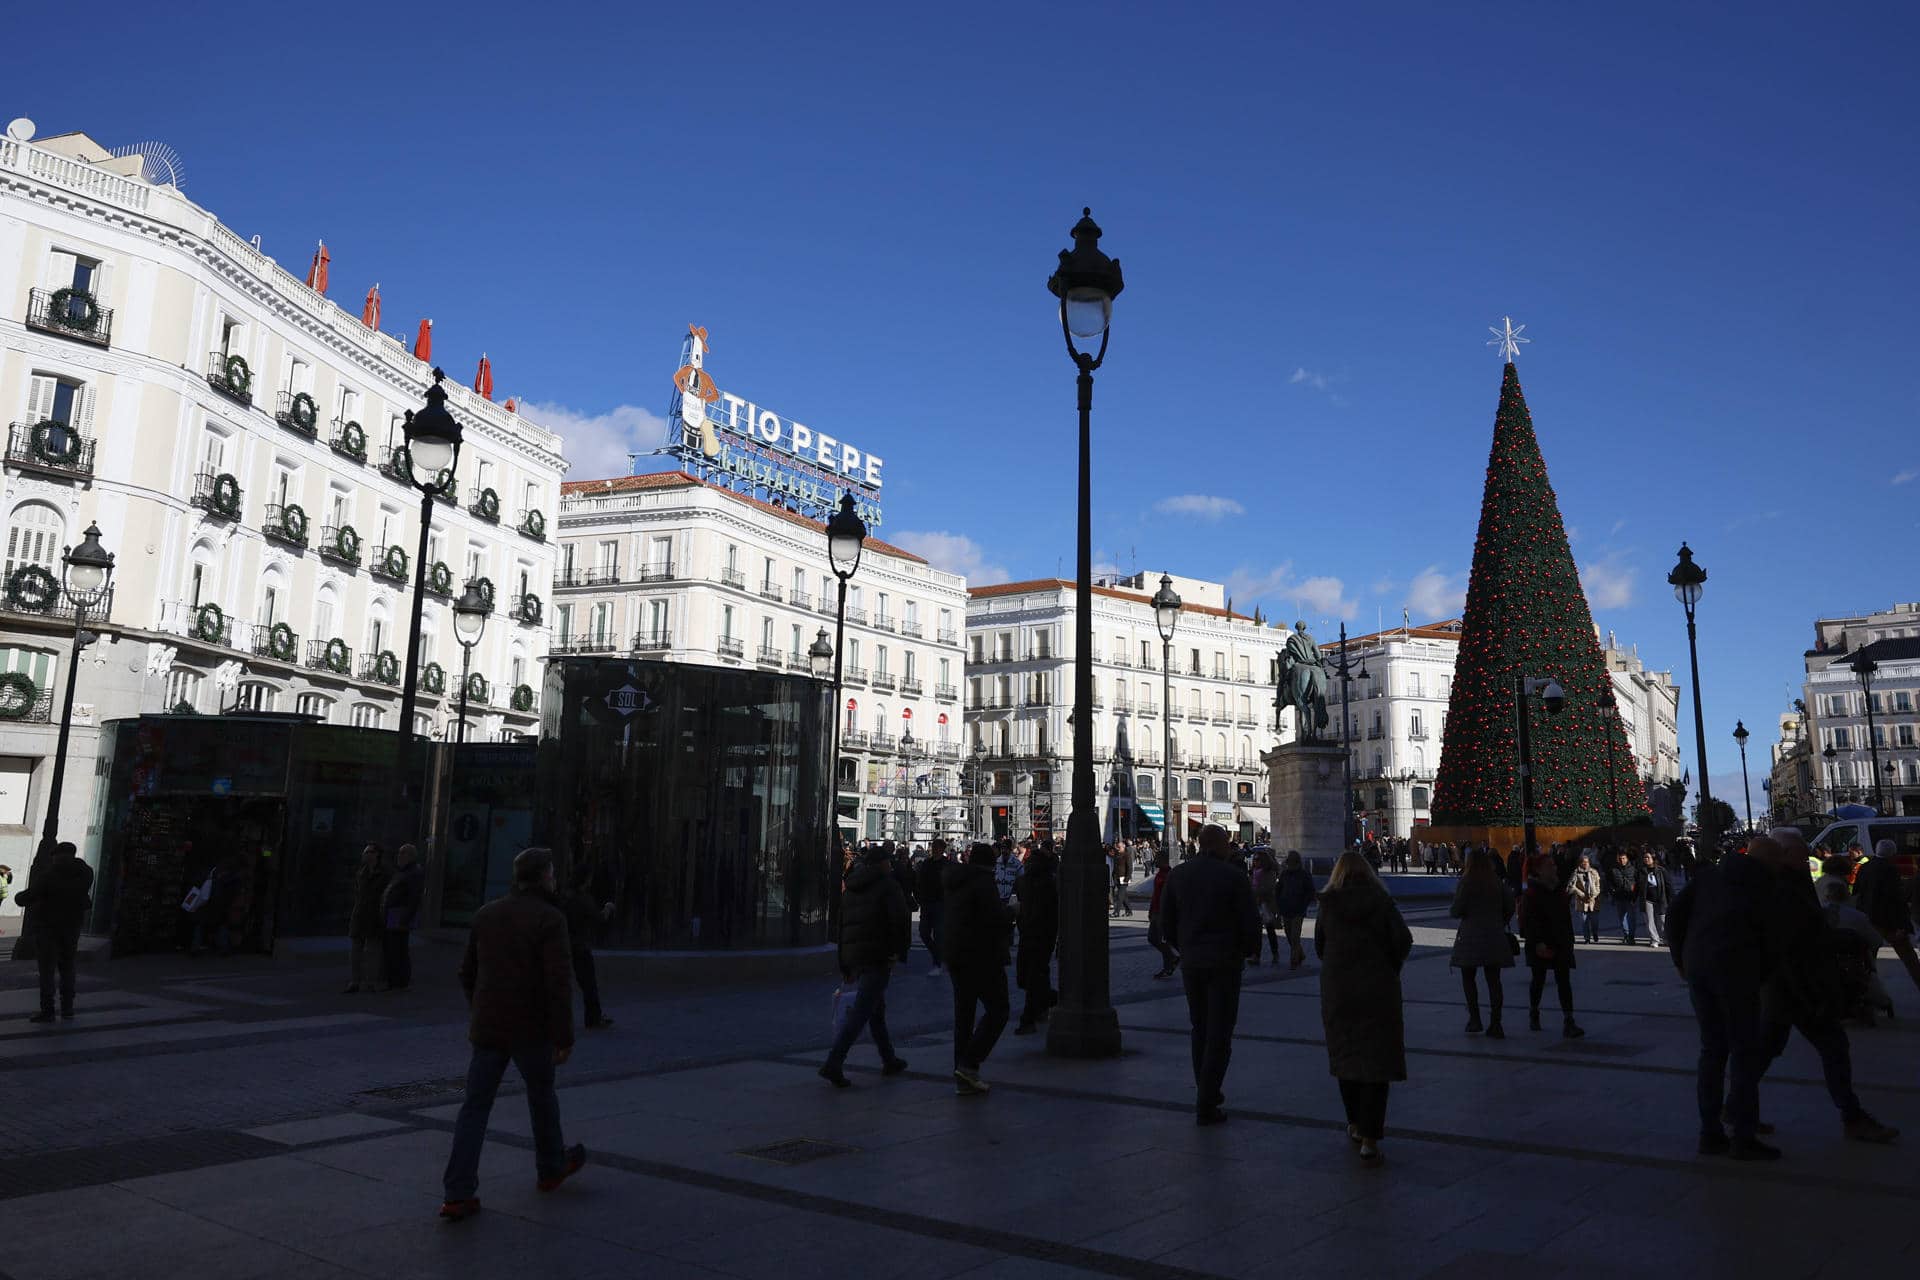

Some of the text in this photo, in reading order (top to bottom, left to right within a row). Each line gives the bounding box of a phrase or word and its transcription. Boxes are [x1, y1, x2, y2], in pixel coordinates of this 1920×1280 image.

[723, 391, 782, 443] TIO
[792, 421, 883, 488] PEPE
[618, 692, 637, 706] SOL
